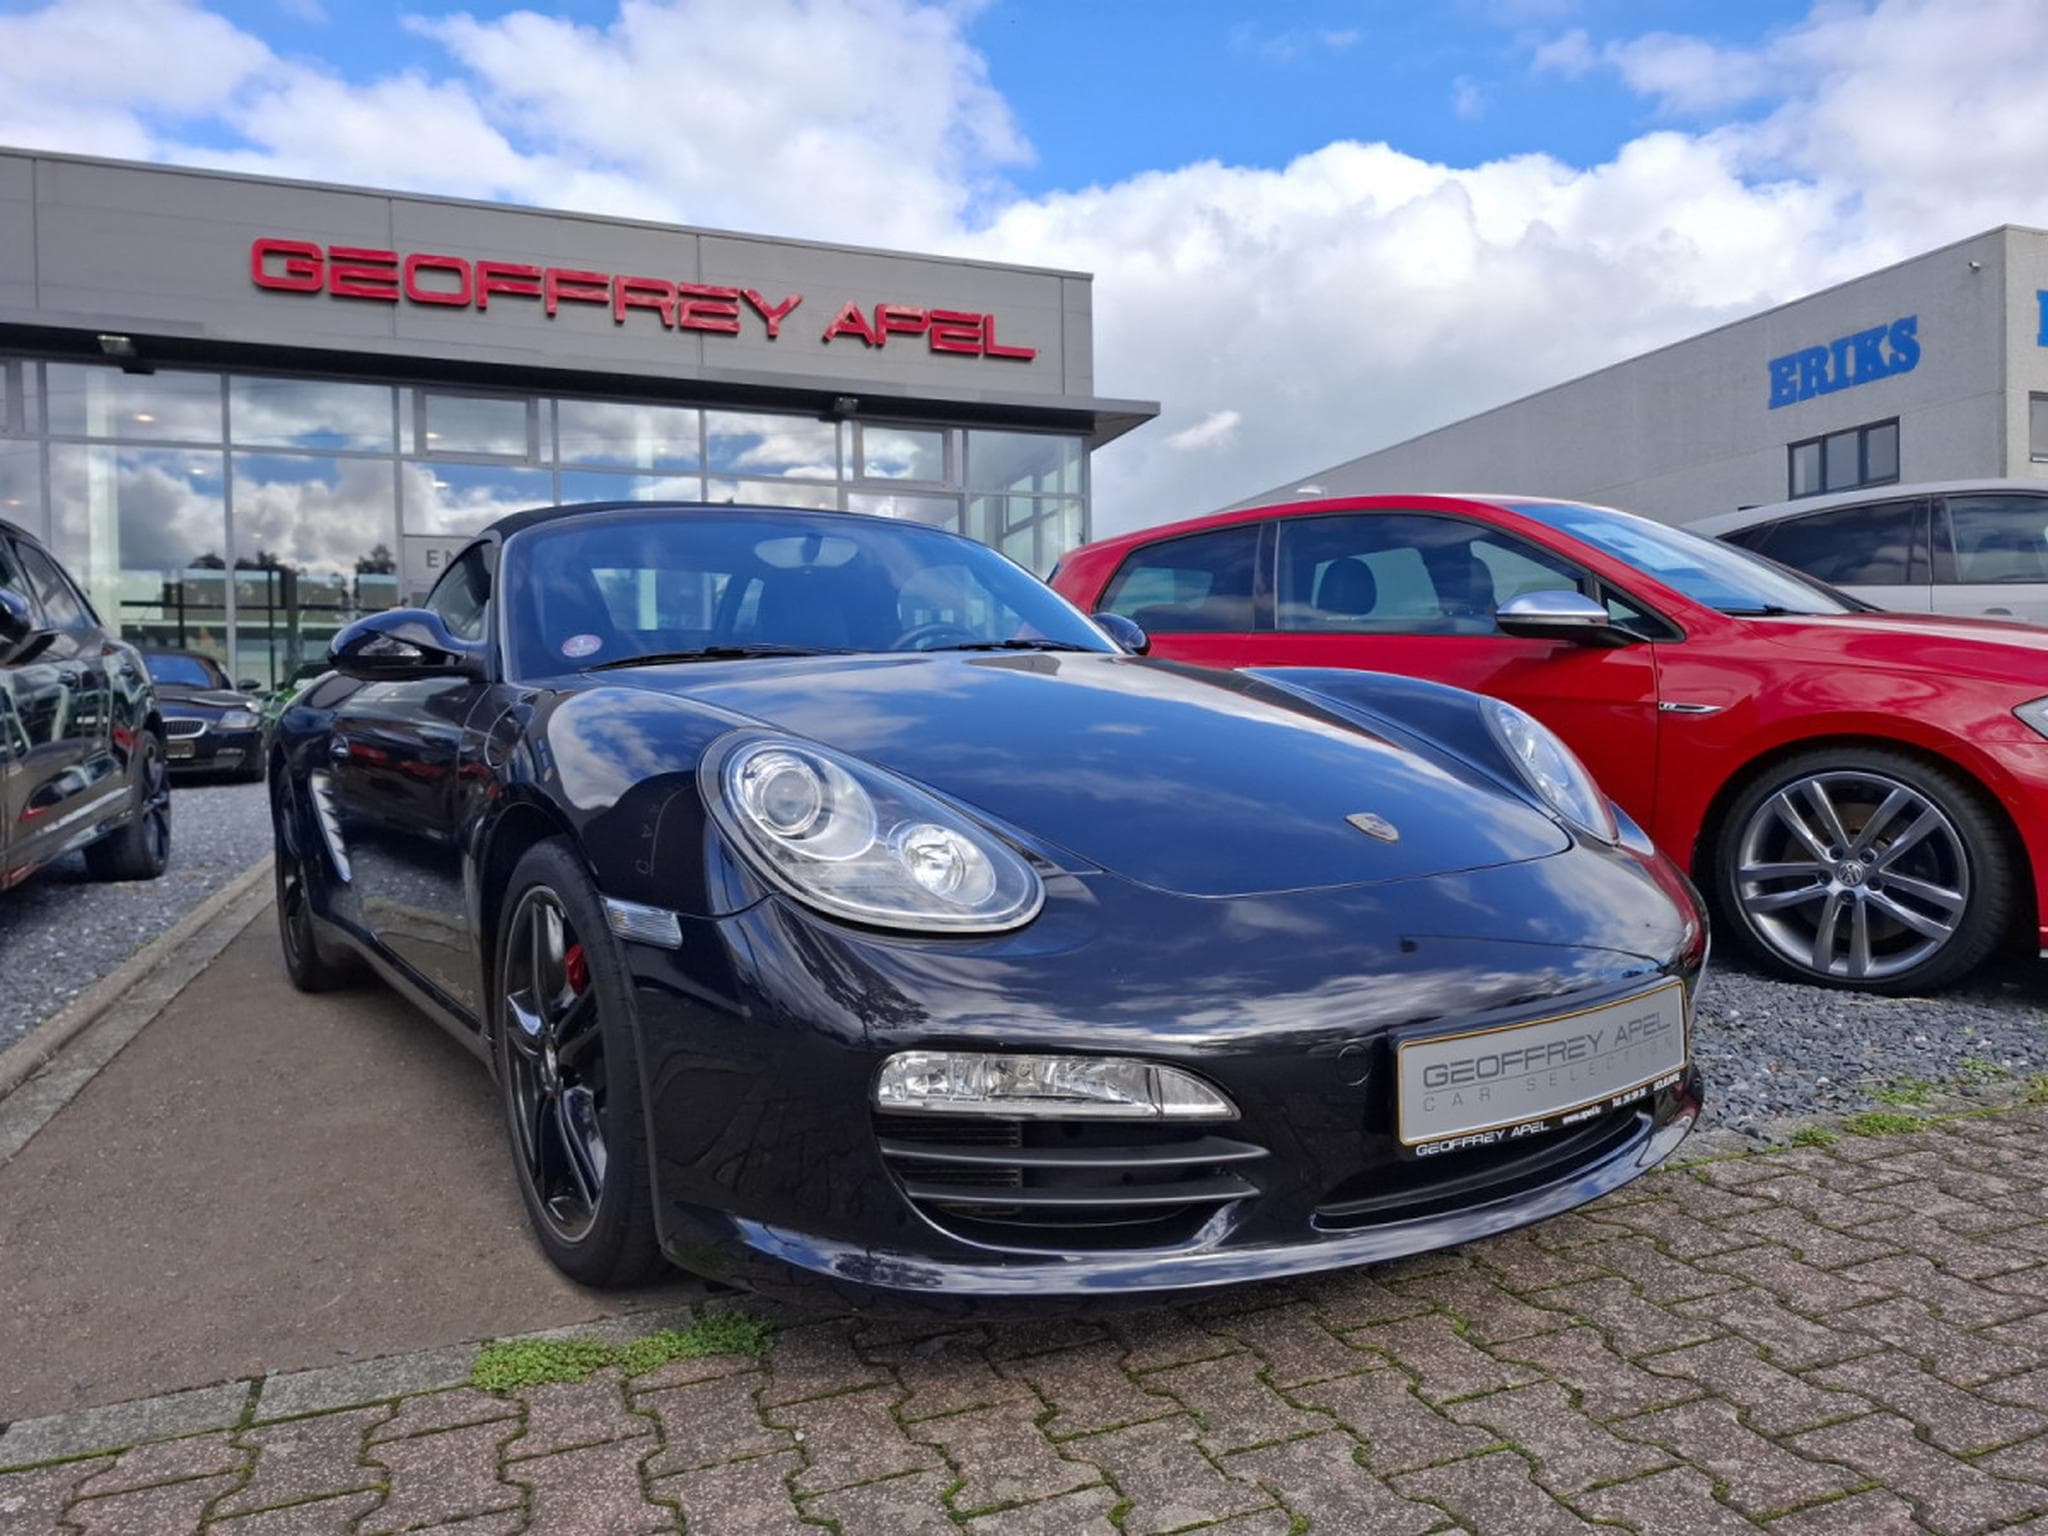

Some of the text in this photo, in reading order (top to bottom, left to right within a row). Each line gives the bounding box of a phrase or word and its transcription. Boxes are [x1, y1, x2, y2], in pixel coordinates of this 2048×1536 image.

[250, 238, 1038, 360] GEOFFREY APEL
[1767, 314, 1921, 410] ERIKS
[1423, 1029, 1605, 1089] GEOFFREY
[1614, 1011, 1671, 1046] APEL
[1423, 1086, 1492, 1113] CAR
[1525, 1035, 1674, 1093] SELECTN
[1416, 1120, 1551, 1157] GEOFFREY APEL
